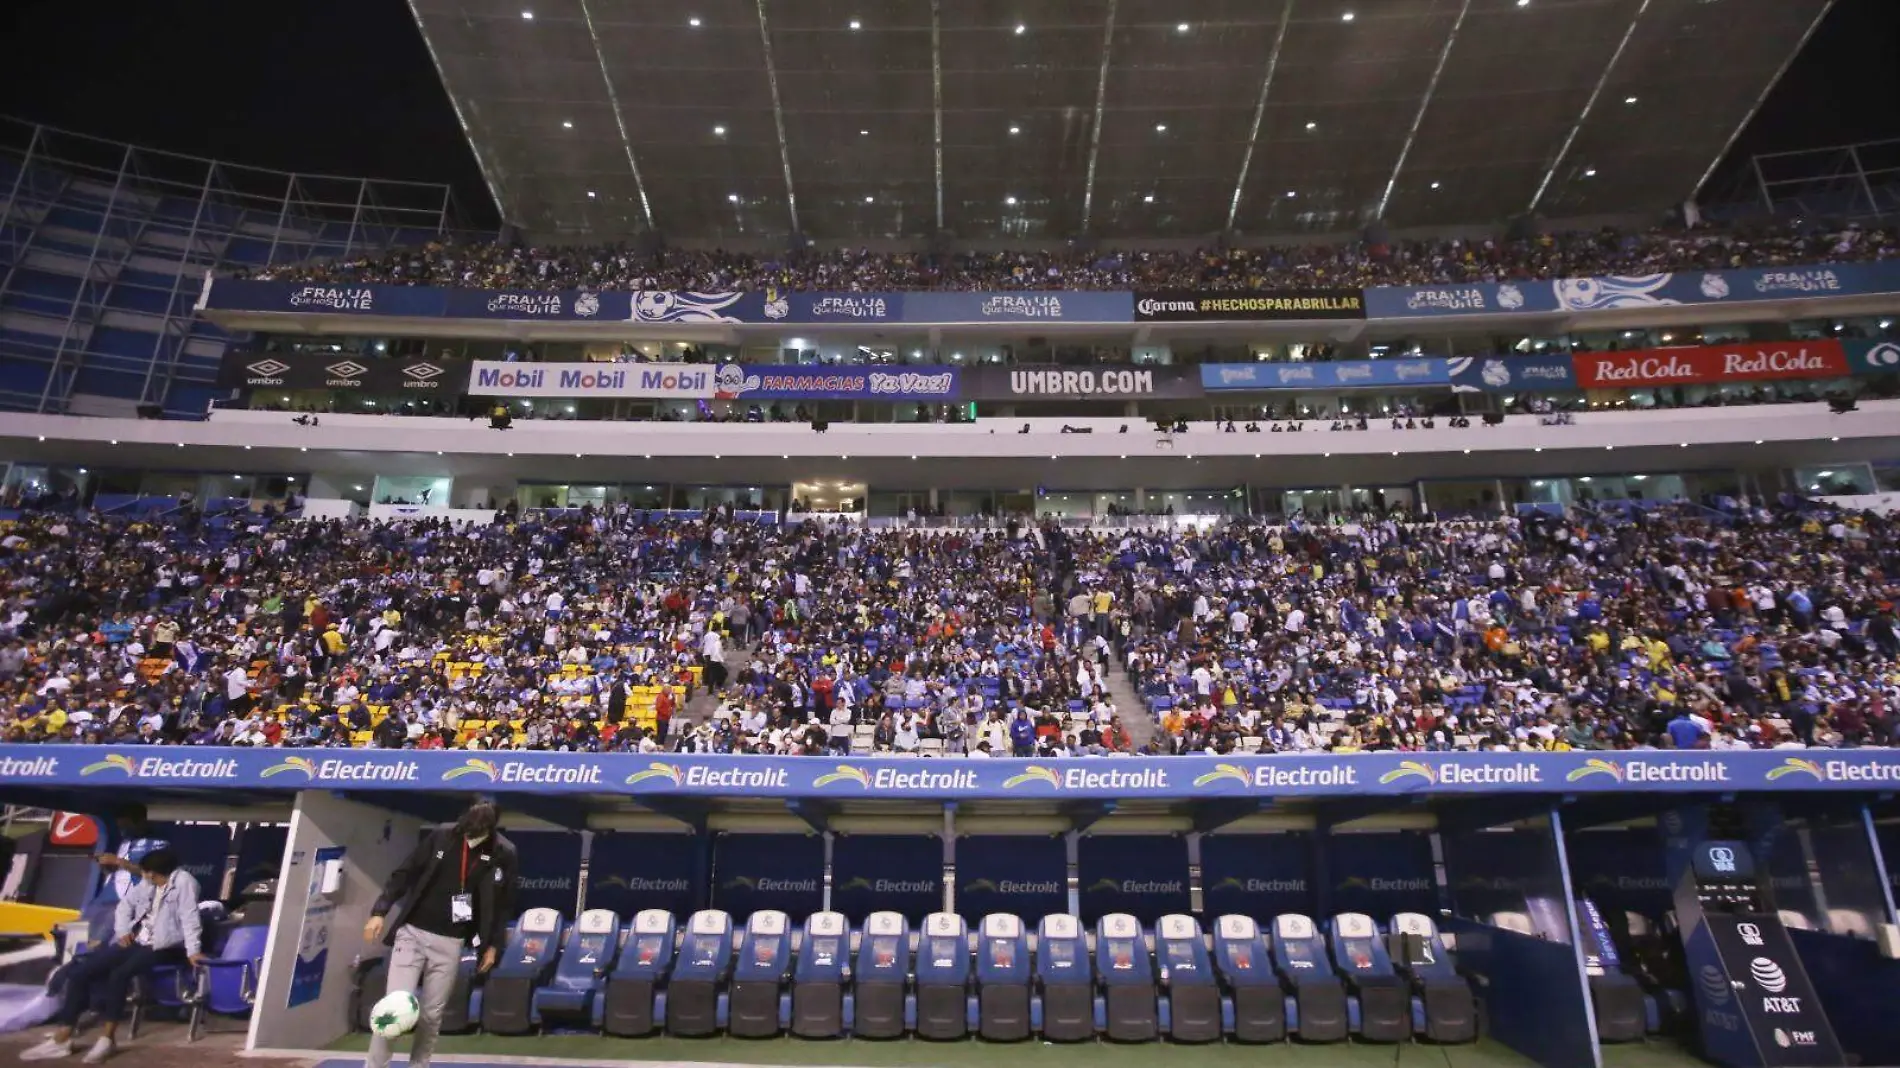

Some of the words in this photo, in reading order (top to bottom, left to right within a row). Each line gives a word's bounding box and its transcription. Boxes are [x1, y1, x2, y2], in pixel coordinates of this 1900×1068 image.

[1137, 297, 1197, 316] Corona
[1199, 297, 1361, 311] #HECHOSPARABRILLAR
[247, 377, 284, 385] umbro
[325, 379, 362, 387] umbro
[403, 380, 438, 388] umbro
[478, 368, 544, 388] Mobil
[559, 369, 625, 389] Mobil
[641, 371, 706, 390] Mobil
[762, 375, 865, 391] FARMACIAS
[1011, 370, 1153, 394] UMBRO.COM
[0, 756, 59, 776] trolit
[139, 757, 239, 778] Electrolit
[319, 759, 419, 781] Electrolit
[501, 761, 603, 784] Electrolit
[1255, 765, 1358, 786] Electrolit
[1439, 762, 1543, 784] Electrolit
[1626, 761, 1729, 782] Electrolit
[686, 765, 789, 788] Electrolit
[874, 767, 979, 789] Electrolit
[1064, 767, 1170, 788] Electrolit
[629, 877, 690, 891] Electrolit
[757, 877, 817, 892] Electrolit
[875, 879, 936, 894] Electrolit
[999, 879, 1060, 893] Electrolit
[1122, 879, 1183, 894] Electrolit
[1247, 878, 1307, 892] Electrolit
[1371, 877, 1431, 891] Electrolit
[1763, 996, 1801, 1013] AT&T
